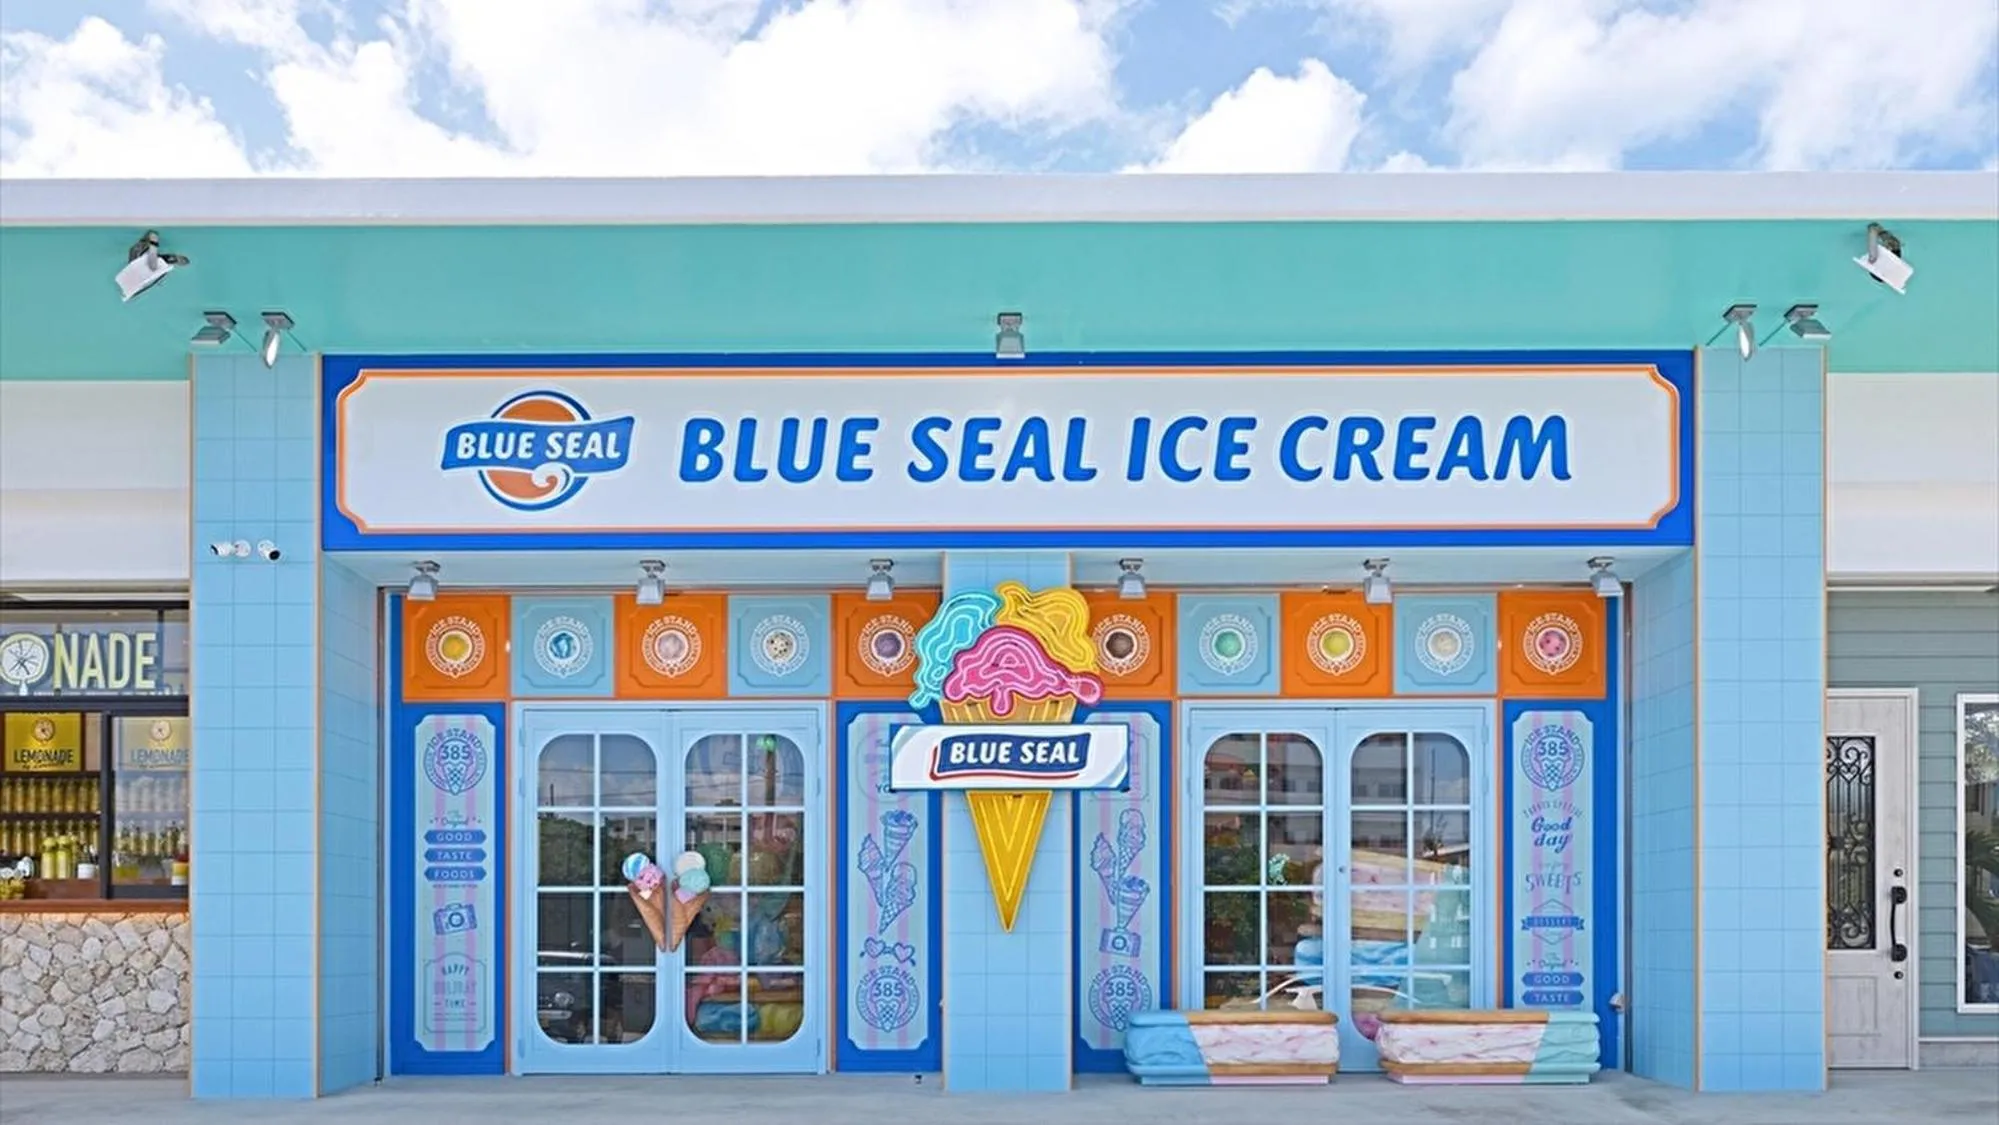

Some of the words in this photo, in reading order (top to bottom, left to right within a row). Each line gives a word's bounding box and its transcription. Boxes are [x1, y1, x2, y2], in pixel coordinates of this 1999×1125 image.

[456, 432, 536, 460] BLUE
[545, 431, 621, 460] SEAL
[679, 416, 880, 484] BLUE
[907, 415, 1098, 484] SEAL
[1126, 415, 1258, 483] ICE
[1279, 414, 1573, 483] CREAM
[430, 620, 446, 636] ICE
[447, 616, 481, 636] STAND
[646, 619, 662, 635] ICE
[663, 616, 698, 635] STAND
[1311, 618, 1327, 634] ICE
[1328, 614, 1362, 634] STAND
[14, 749, 74, 764] LEMONADE
[440, 745, 471, 760] 385
[950, 741, 1011, 764] BLUE
[1019, 741, 1080, 764] SEAL
[1538, 741, 1569, 756] 385
[1531, 816, 1572, 833] Good
[436, 832, 473, 842] GOOD
[1534, 833, 1573, 854] day
[436, 851, 473, 861] TASTE
[1533, 975, 1570, 985] GOOD
[874, 982, 905, 997] 385
[1105, 981, 1136, 997] 385
[1534, 994, 1570, 1003] TASTE
